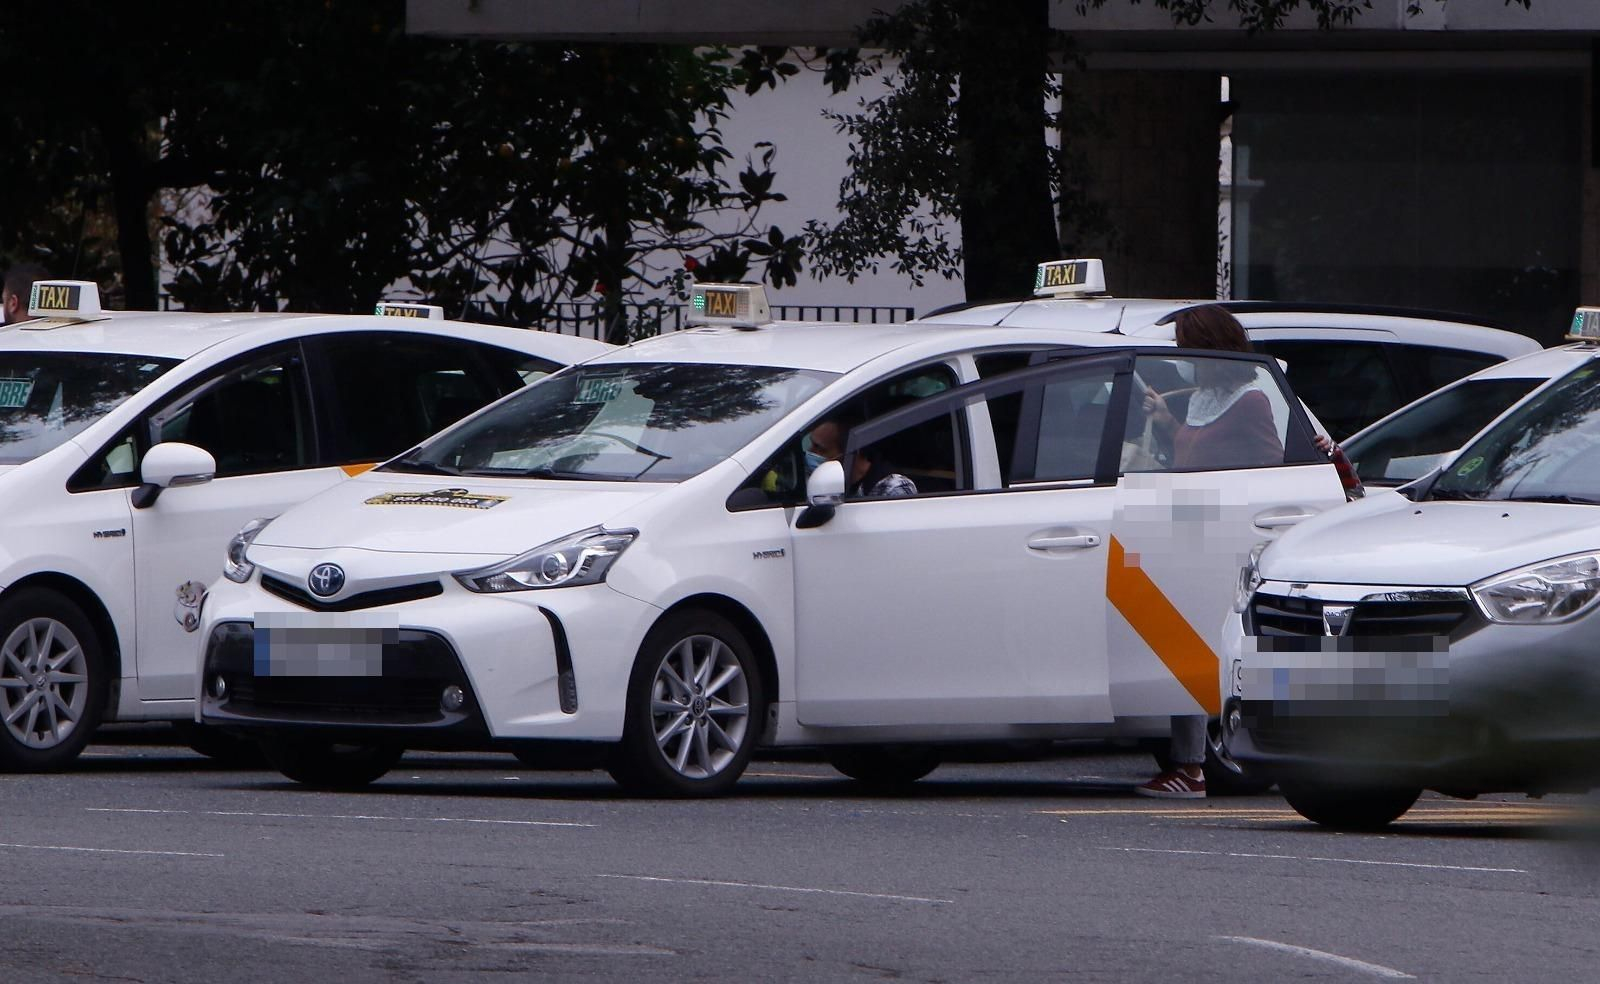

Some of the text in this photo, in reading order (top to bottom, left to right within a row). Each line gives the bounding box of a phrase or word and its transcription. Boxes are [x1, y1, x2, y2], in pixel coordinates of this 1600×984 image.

[1046, 264, 1076, 285] TAXI
[41, 286, 70, 308] TAXI
[705, 292, 736, 315] TAXI
